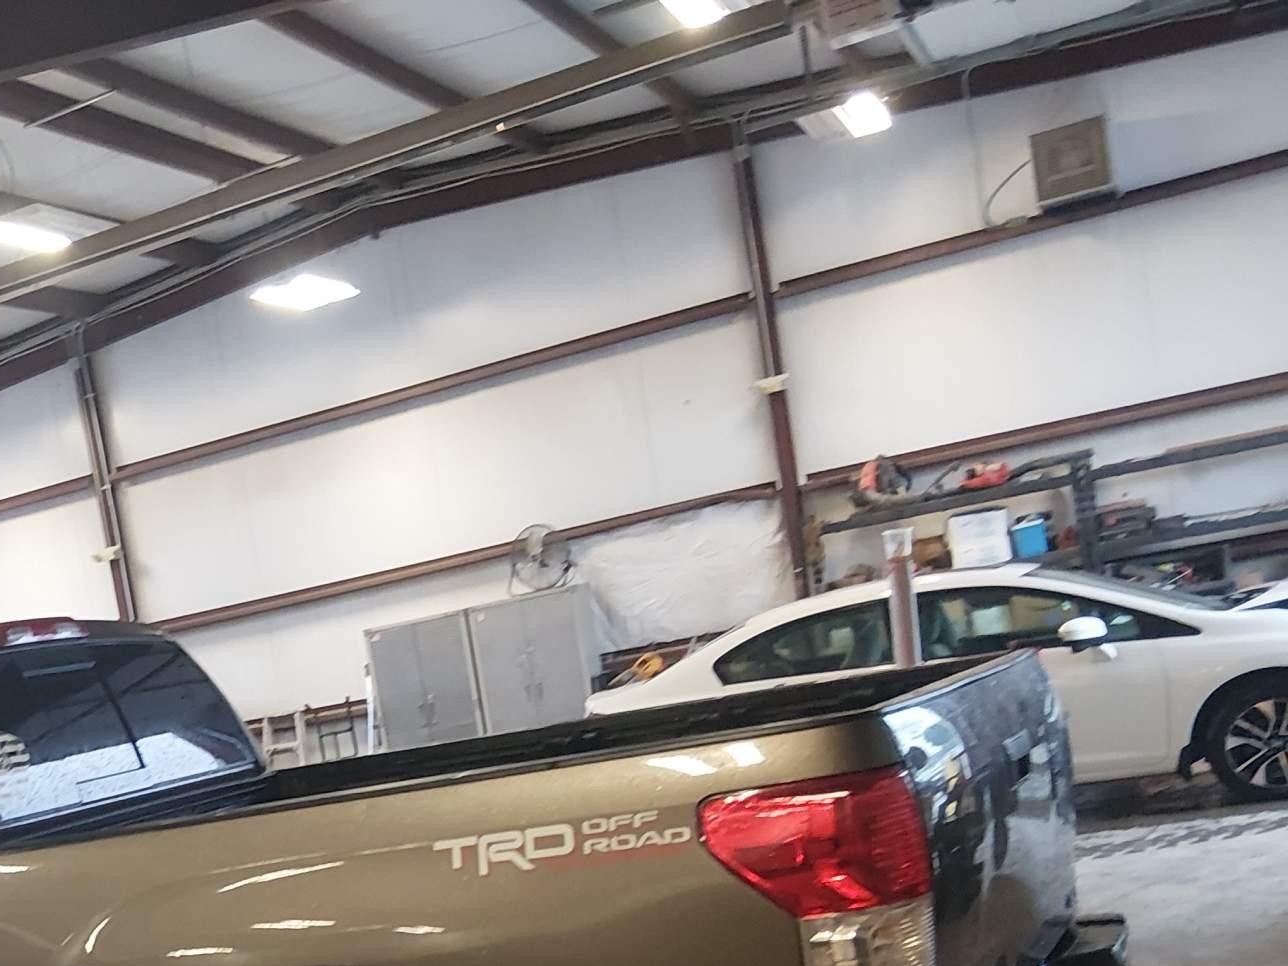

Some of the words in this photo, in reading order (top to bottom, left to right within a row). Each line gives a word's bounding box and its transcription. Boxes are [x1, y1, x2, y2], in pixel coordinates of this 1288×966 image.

[581, 810, 659, 835] OFF
[433, 823, 575, 876] TRD
[583, 826, 691, 855] ROAD
